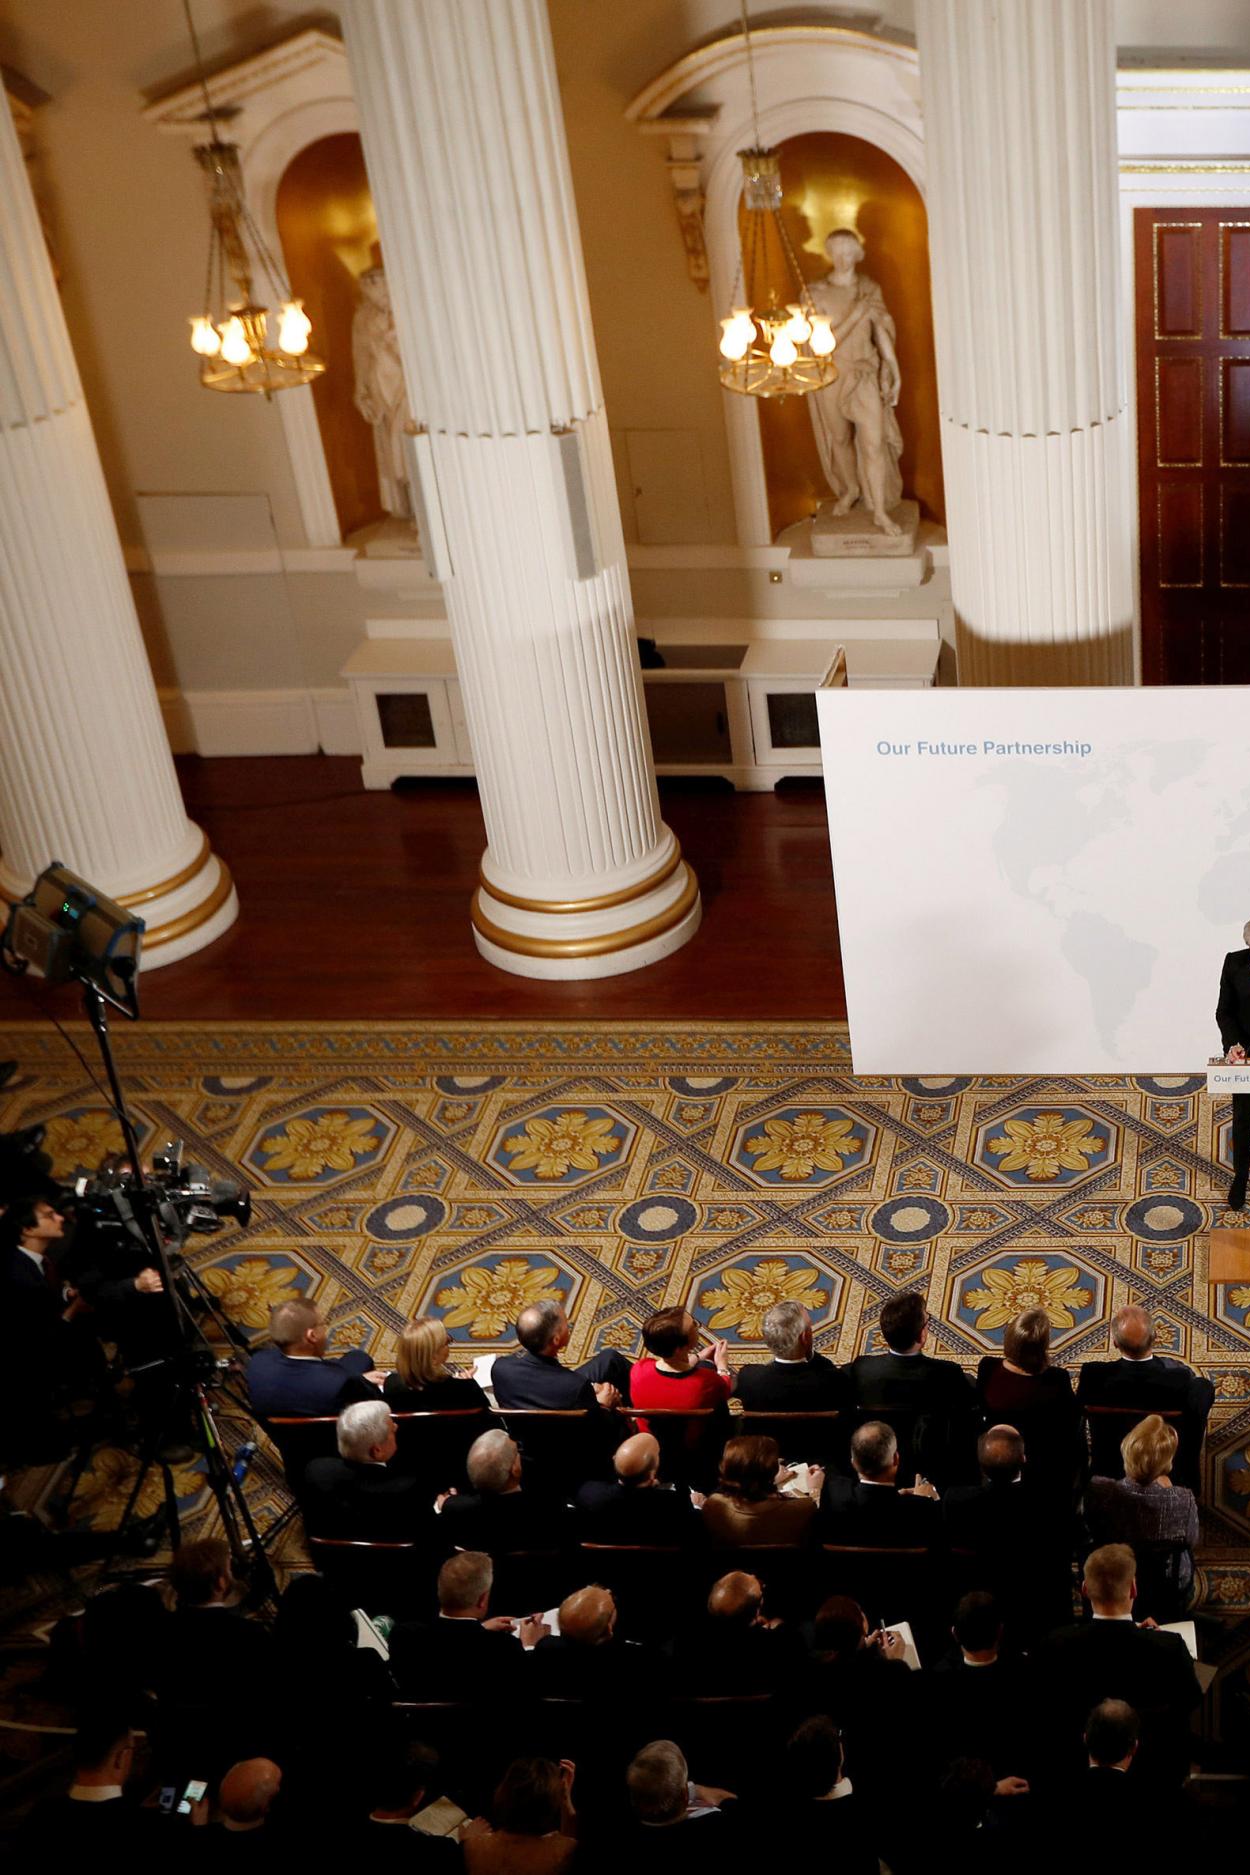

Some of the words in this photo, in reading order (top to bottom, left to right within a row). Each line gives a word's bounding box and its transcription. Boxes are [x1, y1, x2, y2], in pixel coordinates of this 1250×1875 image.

[876, 741, 911, 756] Our
[917, 741, 978, 756] Future
[983, 740, 1093, 757] Partnership
[1213, 1075, 1231, 1083] Our
